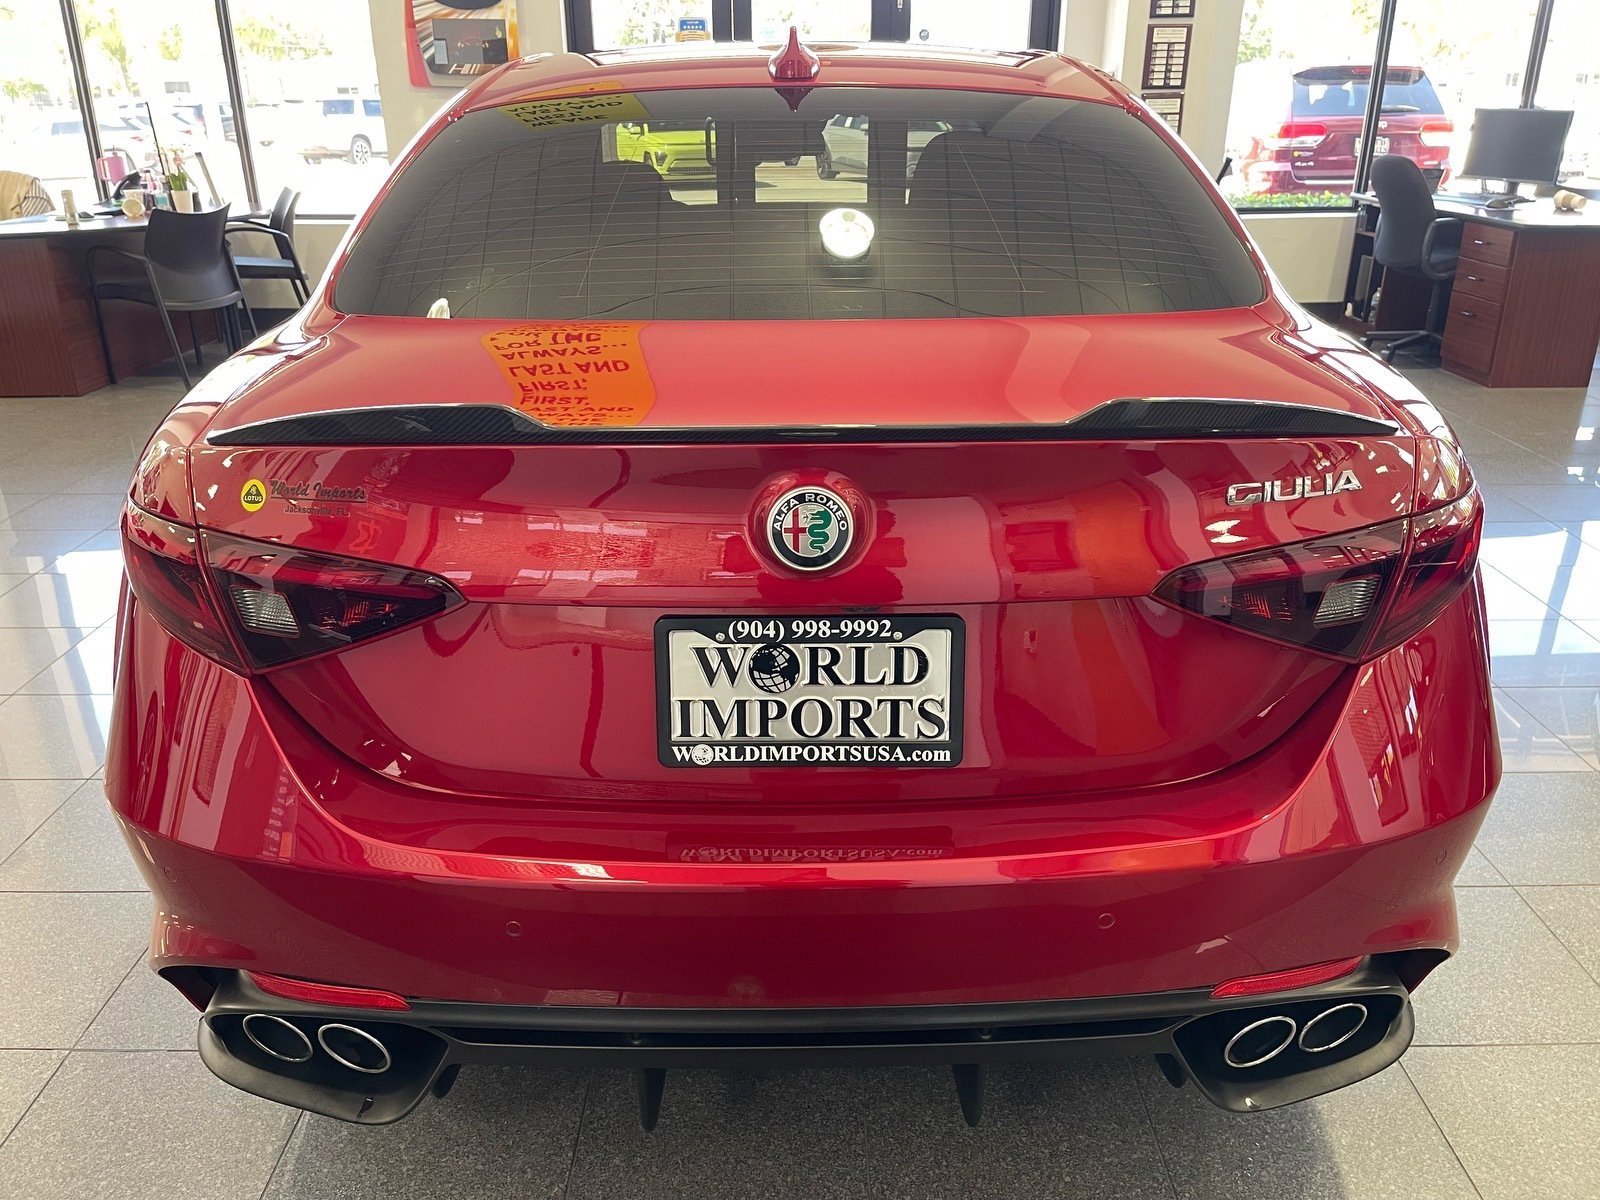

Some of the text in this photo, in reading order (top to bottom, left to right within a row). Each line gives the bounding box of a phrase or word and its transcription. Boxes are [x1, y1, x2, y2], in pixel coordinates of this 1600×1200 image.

[270, 479, 367, 500] World Imports
[1226, 469, 1363, 506] GIULIA
[773, 493, 849, 532] ALFA ROMEO
[728, 618, 893, 642] (904) 998-9992
[690, 642, 932, 694] WORLD
[673, 696, 947, 740] IMPORTS
[671, 743, 951, 765] WORLDIMPORTSUSA.com
